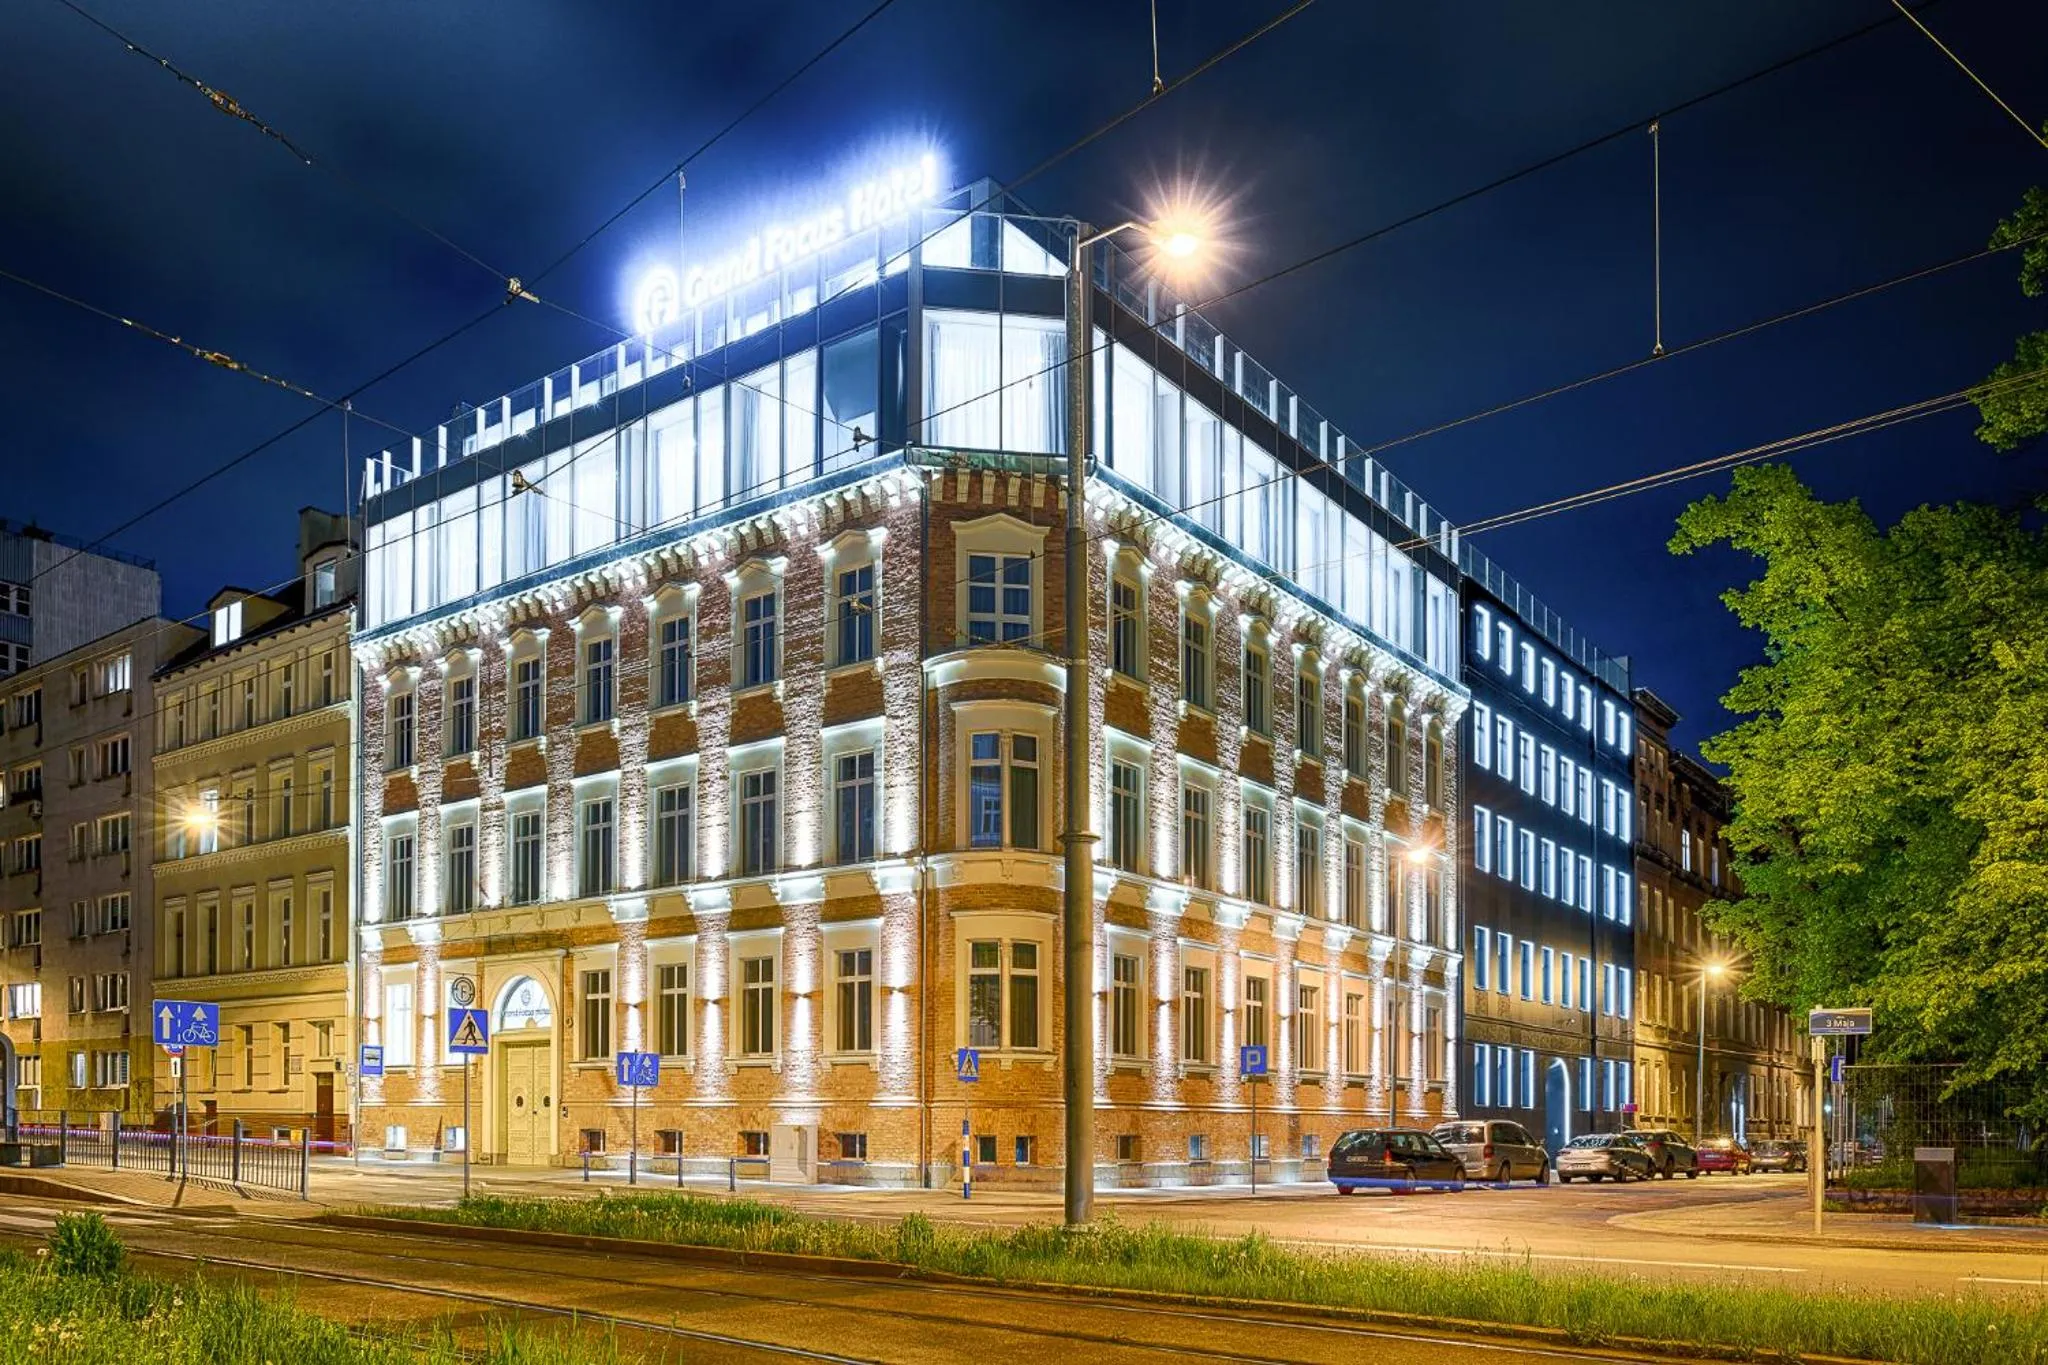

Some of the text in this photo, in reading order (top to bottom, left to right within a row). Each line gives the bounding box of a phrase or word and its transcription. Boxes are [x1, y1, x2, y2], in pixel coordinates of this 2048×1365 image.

[764, 208, 845, 271] Focus
[850, 154, 937, 230] Hotel
[1246, 1050, 1261, 1072] P
